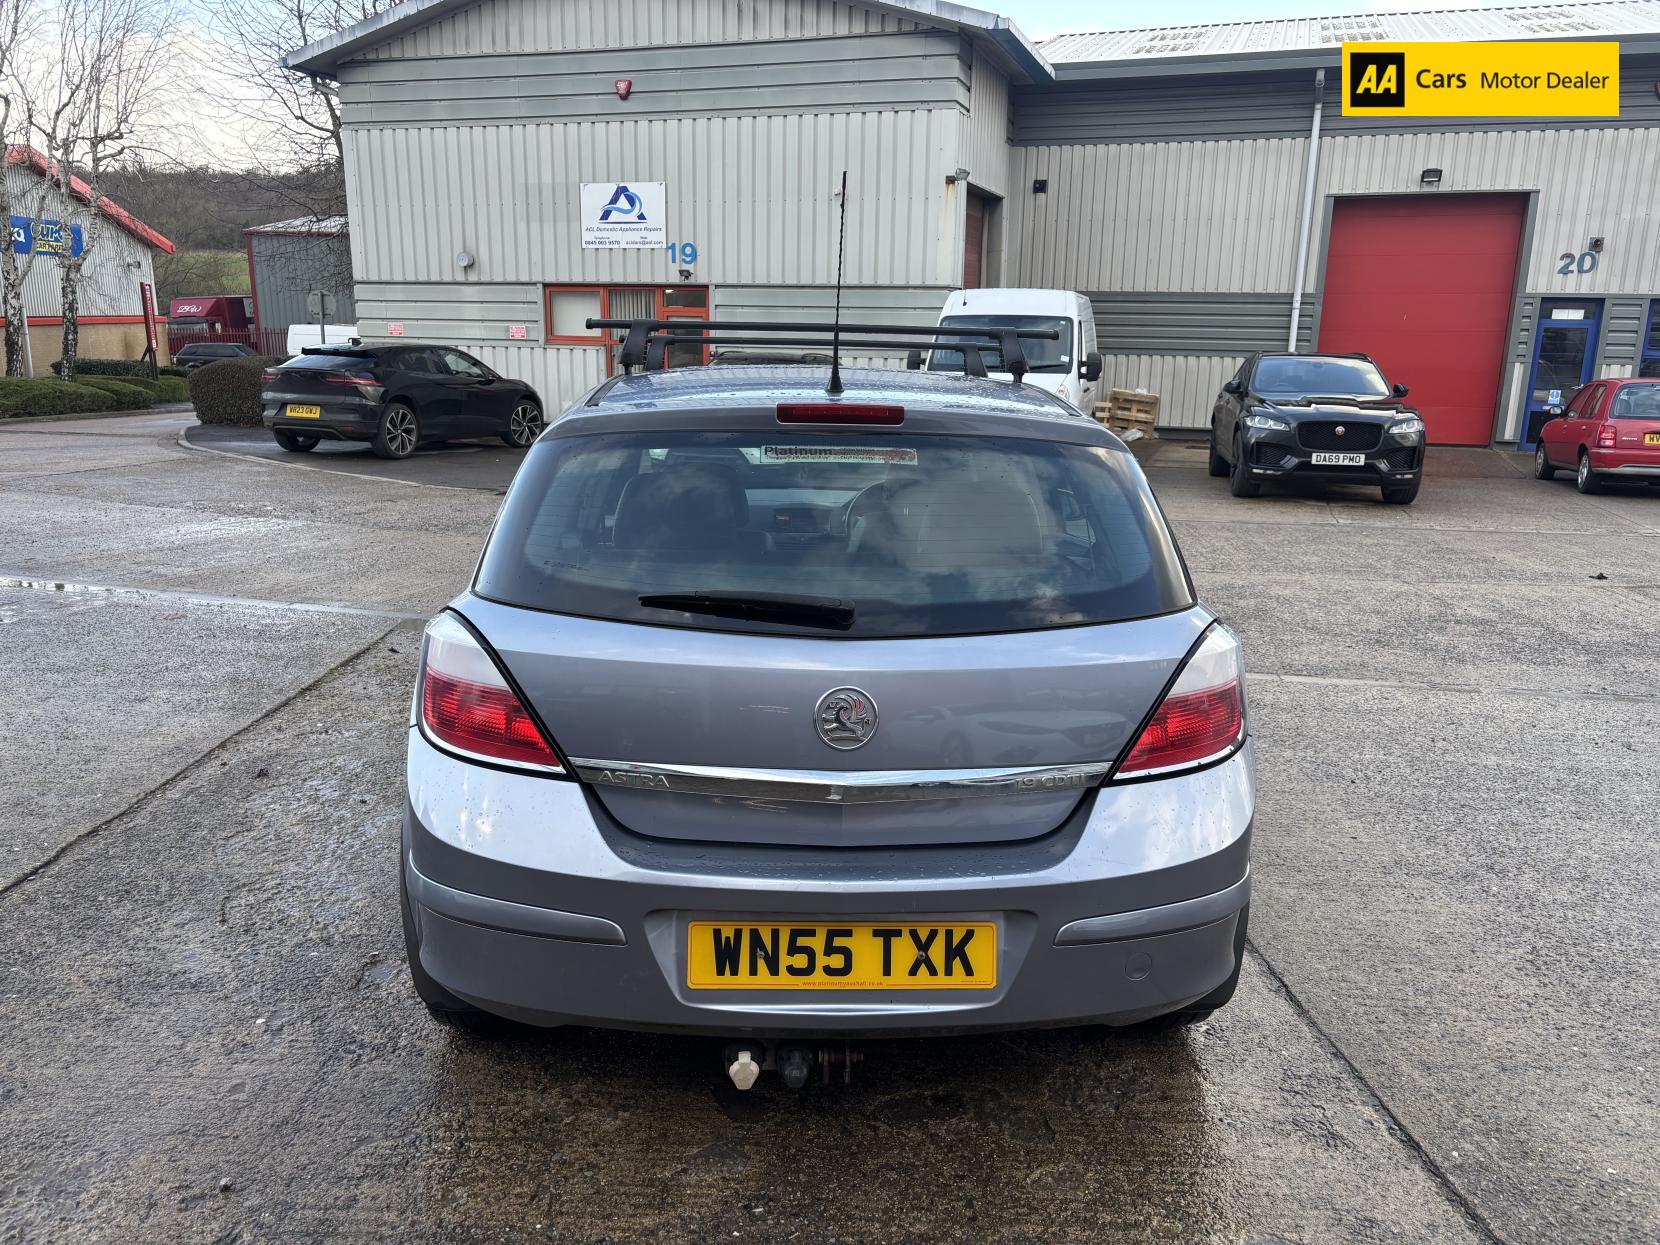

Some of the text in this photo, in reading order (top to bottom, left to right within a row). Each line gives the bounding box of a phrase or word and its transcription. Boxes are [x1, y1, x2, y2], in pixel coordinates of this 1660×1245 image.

[667, 242, 698, 265] 19
[1557, 251, 1597, 274] 20
[764, 446, 833, 456] Platinum
[1315, 454, 1361, 464] DA69 PMO
[599, 770, 670, 788] ASTRA
[712, 928, 975, 976] WN55 TXK
